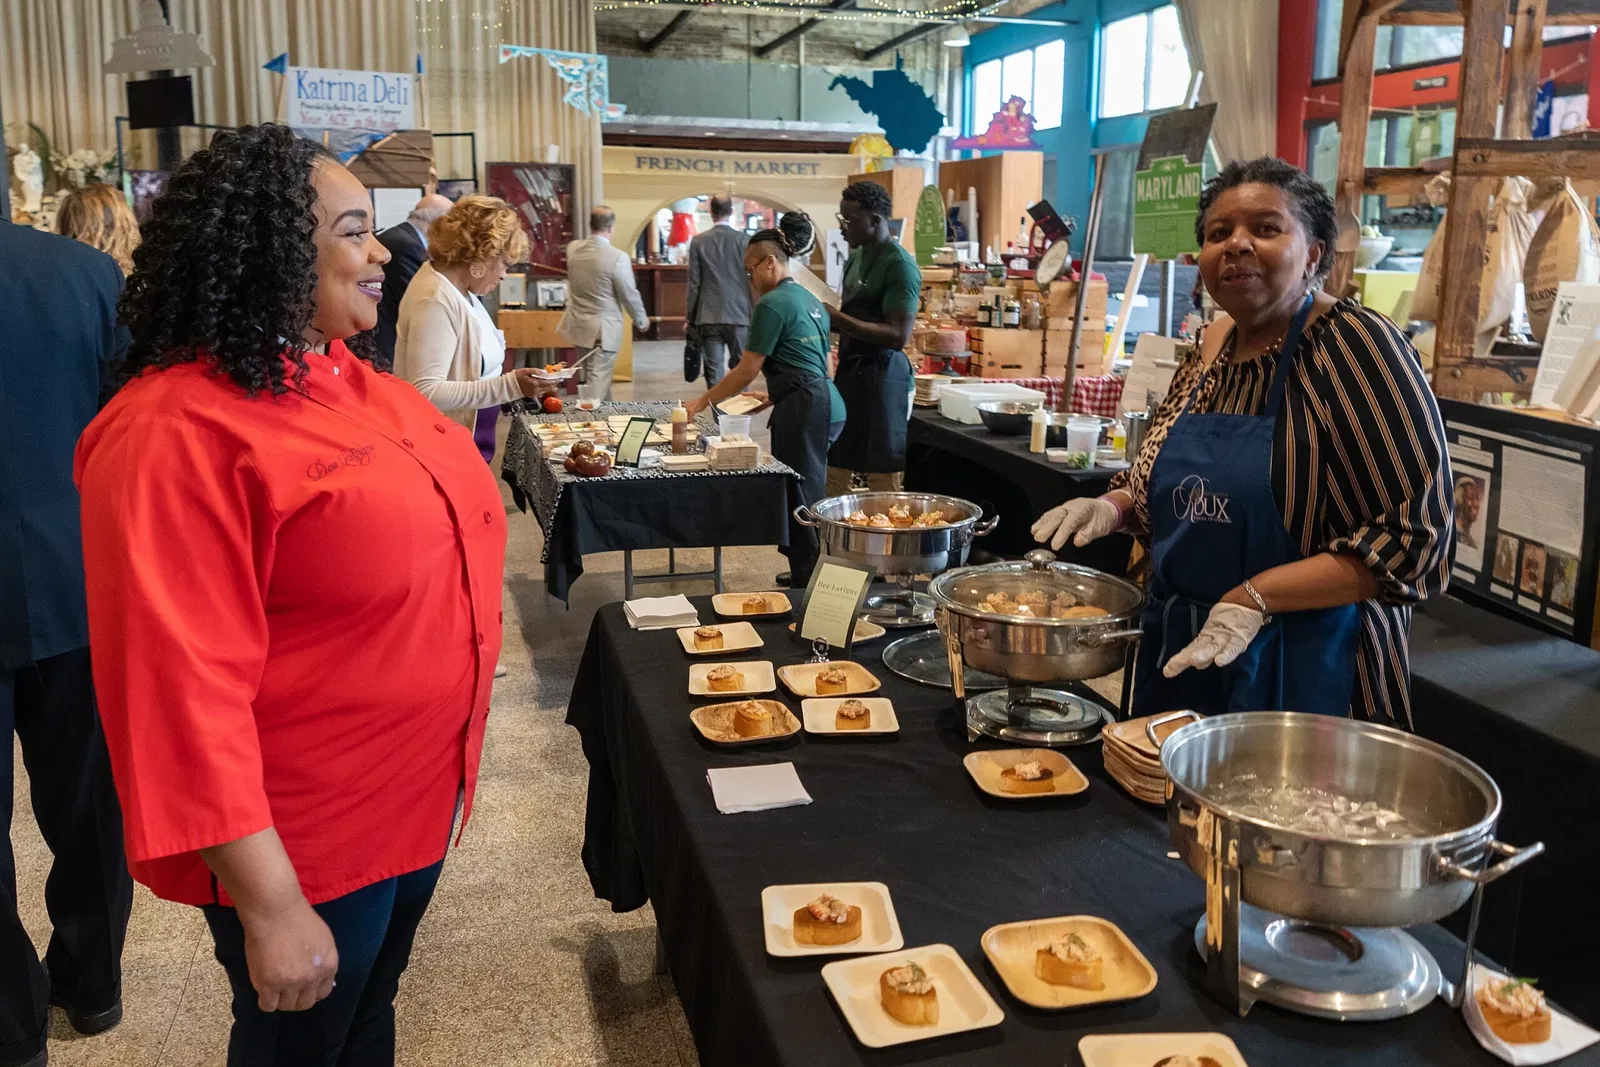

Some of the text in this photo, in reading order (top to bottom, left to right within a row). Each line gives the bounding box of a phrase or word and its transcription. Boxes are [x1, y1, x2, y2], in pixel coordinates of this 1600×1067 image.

[296, 70, 408, 105] Katrina Deli
[635, 155, 821, 176] FRENCH MARKET
[1137, 172, 1201, 202] MARYLAND
[817, 580, 831, 590] Dee
[831, 584, 858, 596] Lavigne
